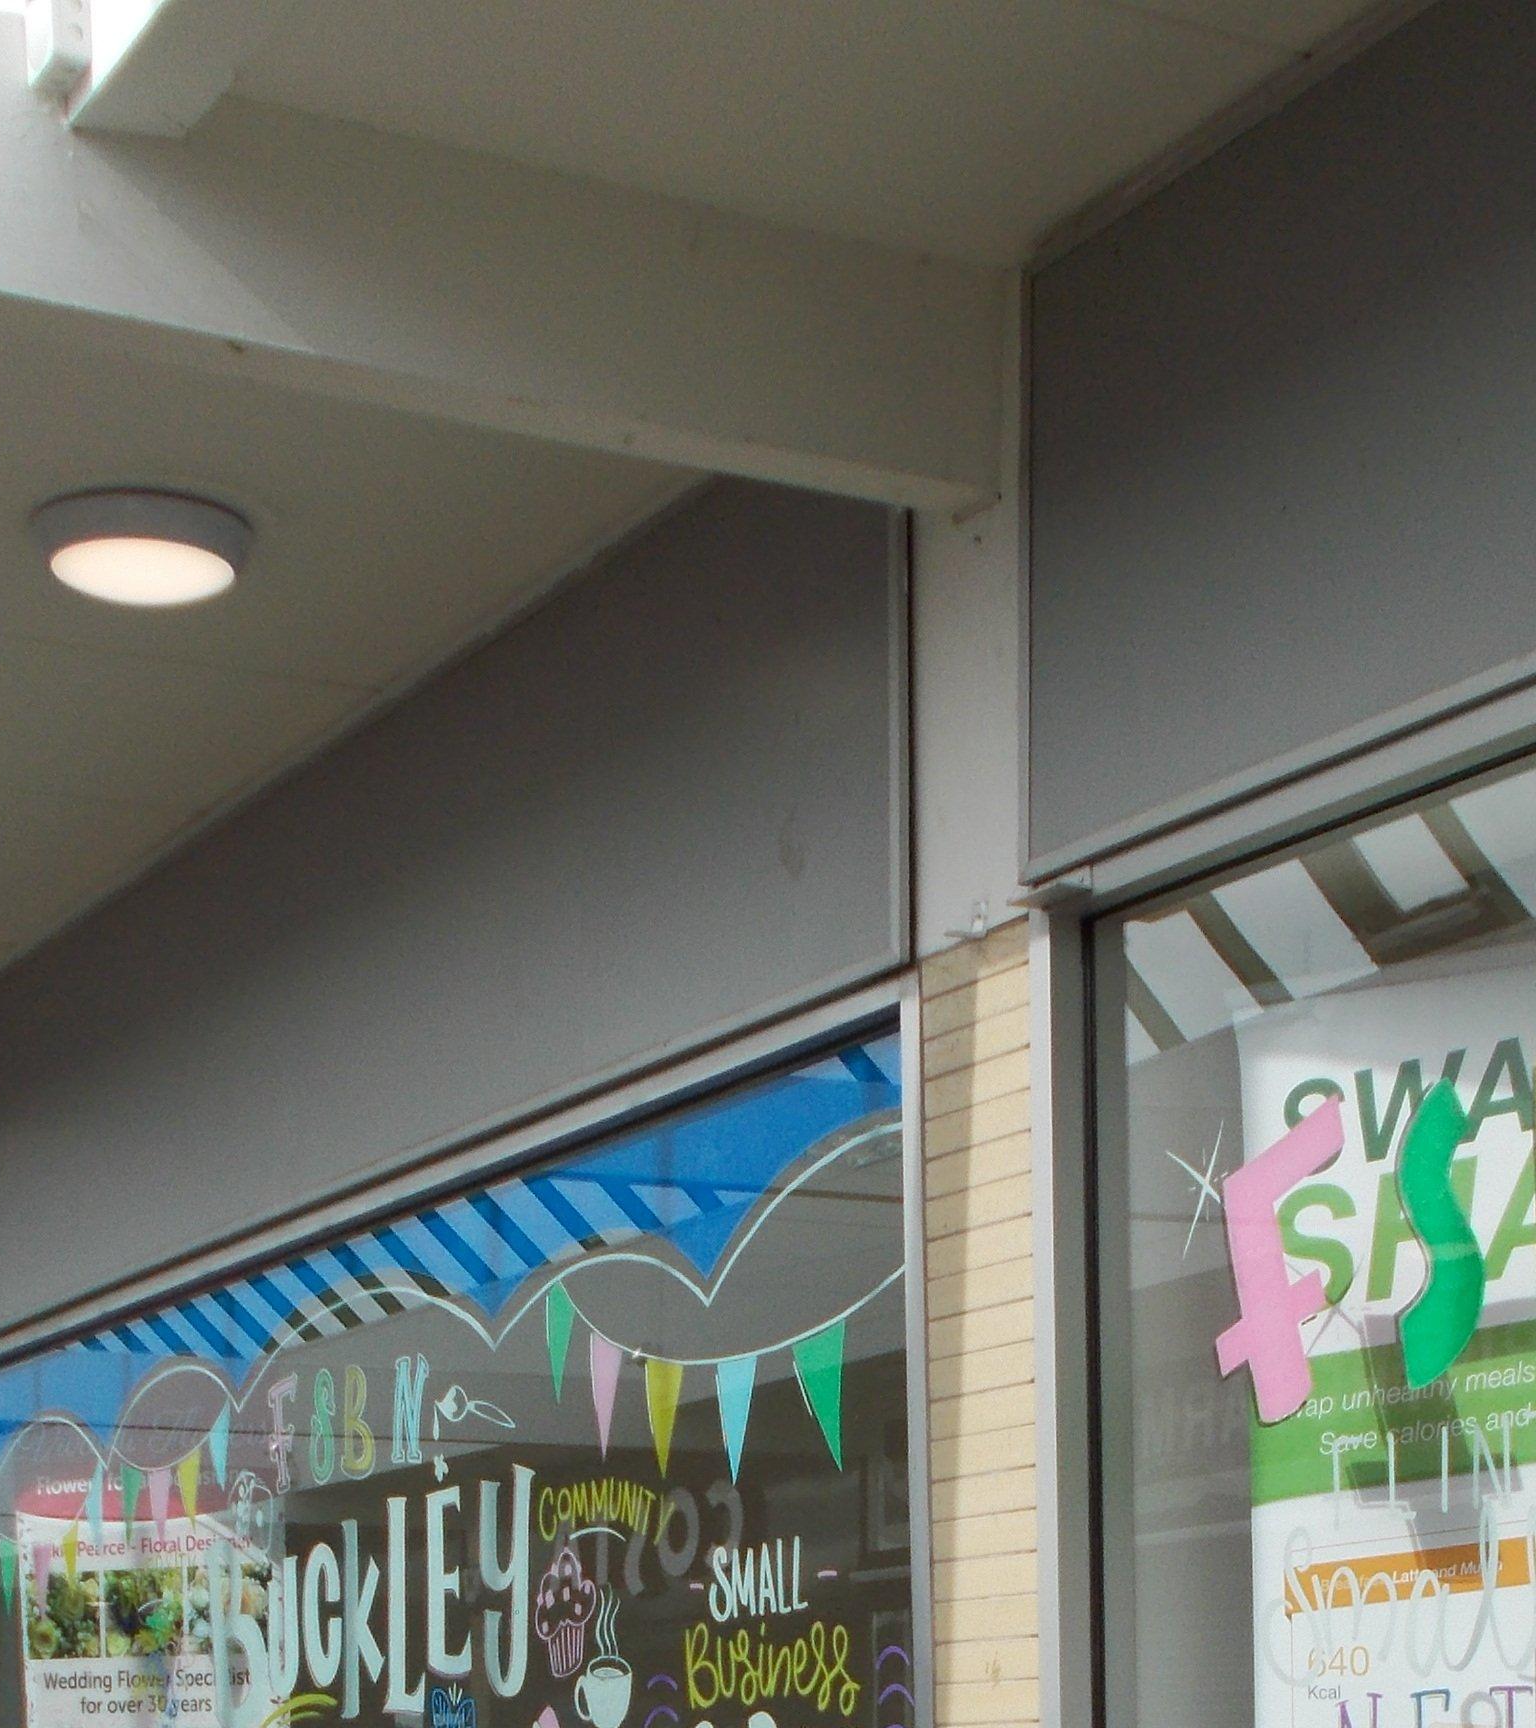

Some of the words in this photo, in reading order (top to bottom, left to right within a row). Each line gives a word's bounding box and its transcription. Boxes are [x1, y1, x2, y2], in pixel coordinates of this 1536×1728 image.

[1465, 1360, 1536, 1393] meals
[267, 1352, 429, 1495] FSBN
[1319, 1430, 1379, 1456] Save
[1387, 1414, 1478, 1444] calories
[1485, 1402, 1532, 1430] and
[539, 1476, 677, 1543] COMMUNITY
[140, 1536, 181, 1554] Floral
[708, 1536, 809, 1622] SMALL
[43, 1669, 114, 1694] Wedding
[685, 1621, 860, 1716] Business
[80, 1697, 101, 1715] for
[107, 1701, 143, 1715] over
[1307, 1684, 1342, 1700] Kcal
